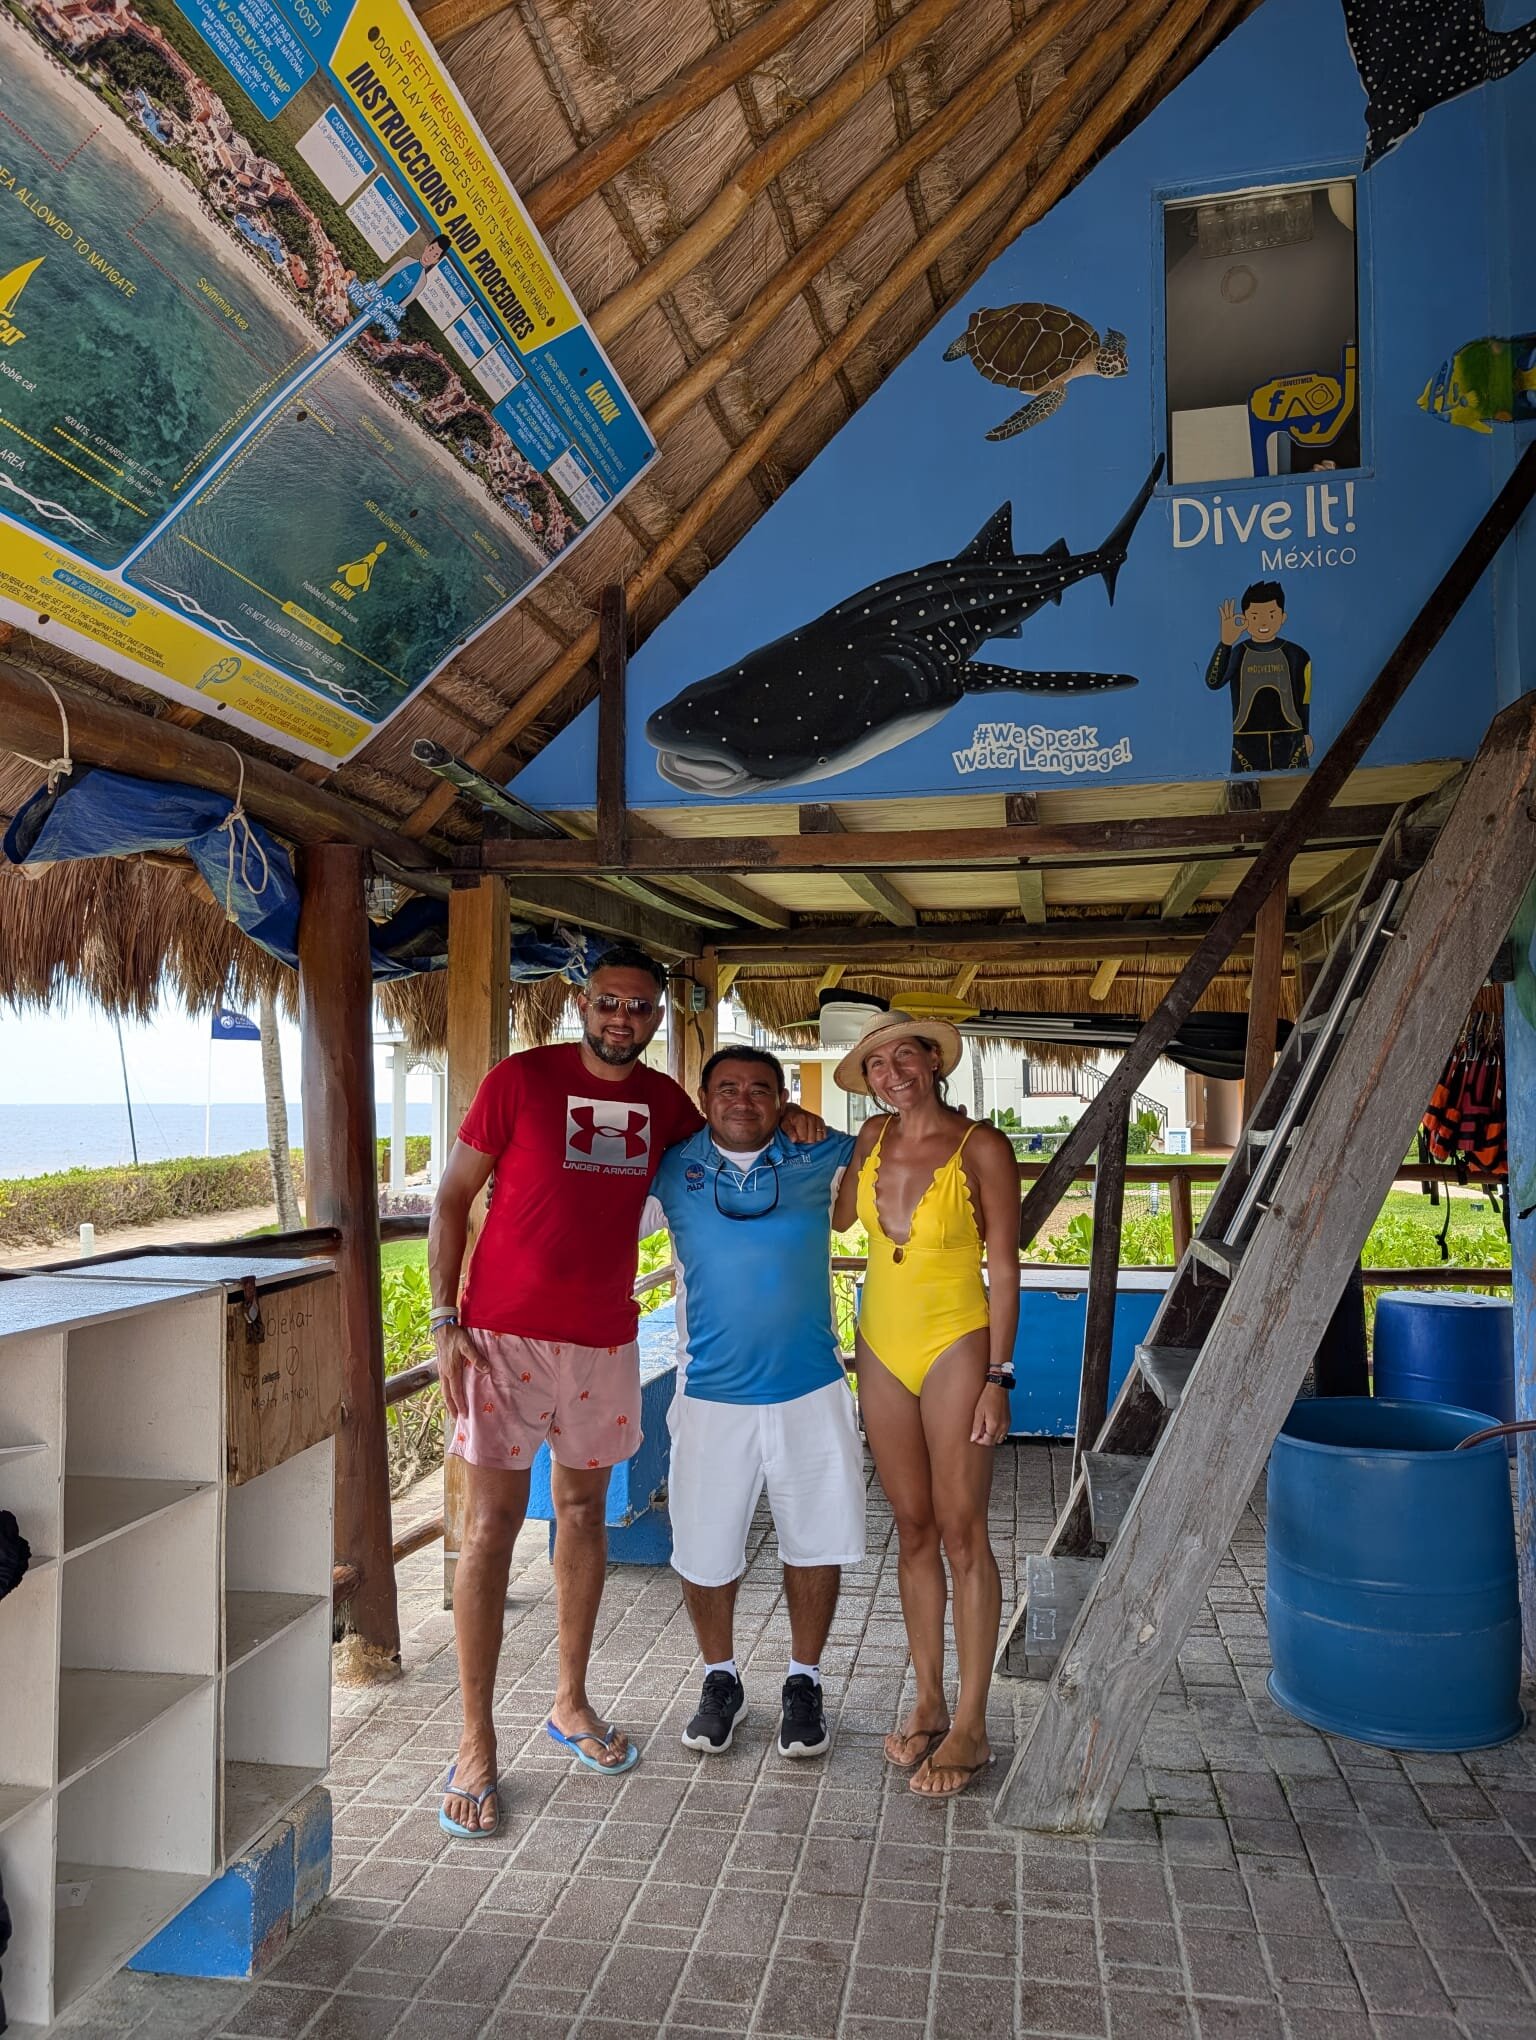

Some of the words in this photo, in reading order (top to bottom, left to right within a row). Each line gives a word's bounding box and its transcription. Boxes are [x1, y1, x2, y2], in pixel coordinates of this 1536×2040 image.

[370, 36, 403, 77] DON'T
[396, 39, 435, 90] SAFETY
[395, 75, 422, 109] PLAY
[415, 106, 443, 141] WITH
[426, 88, 471, 149] MEASURES
[433, 137, 472, 189] PEOPLE'S
[461, 146, 486, 176] MUST
[344, 61, 460, 219] INSTRUCCIONS
[443, 214, 483, 254] AND
[467, 248, 536, 340] PROCEDURES
[462, 185, 491, 220] LIVES,
[478, 175, 504, 207] APPLY
[481, 214, 500, 235] IT'S
[496, 205, 510, 218] IN
[502, 215, 520, 236] ALL
[16, 188, 74, 240] ALLOWED
[72, 236, 91, 255] TO
[86, 251, 138, 299] NAVIGATE
[491, 231, 514, 258] THEIR
[511, 232, 536, 262] WATER
[506, 256, 523, 274] LIFE
[515, 270, 529, 283] IN
[526, 260, 558, 301] ACTIVITIES
[196, 277, 229, 318] Swimming
[231, 312, 249, 330] Area
[347, 279, 369, 309] Water
[363, 282, 384, 301] #We
[381, 296, 406, 320] Speak
[520, 280, 537, 298] OUR
[529, 294, 551, 321] HANDS
[22, 378, 37, 393] cat
[584, 379, 622, 425] KAYAK
[1172, 495, 1293, 549] Dive
[1305, 482, 1357, 538] It!
[1261, 545, 1357, 572] México
[329, 578, 356, 602] KAYAK
[973, 723, 1024, 747] #We
[1029, 726, 1097, 749] Speak
[955, 747, 1016, 771] Water
[1022, 737, 1131, 773] Language!
[562, 1161, 601, 1173] UNDER
[602, 1166, 648, 1177] ARMOUR
